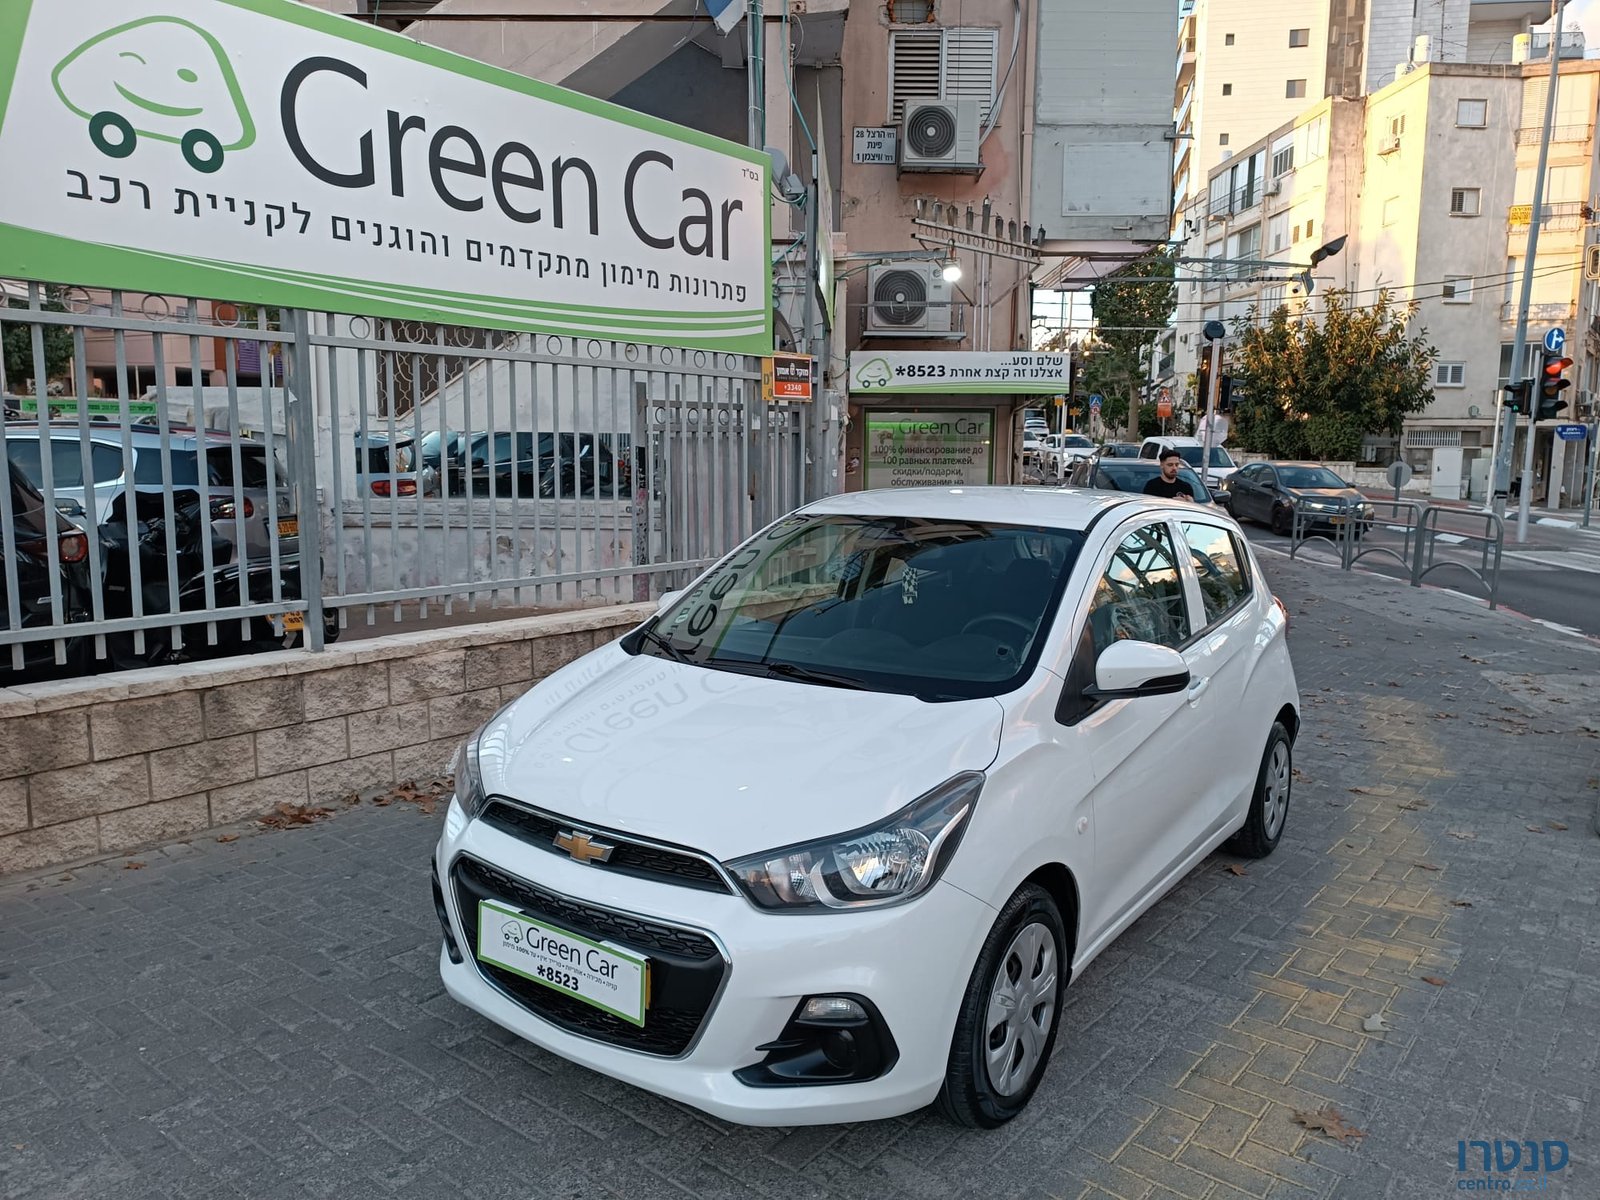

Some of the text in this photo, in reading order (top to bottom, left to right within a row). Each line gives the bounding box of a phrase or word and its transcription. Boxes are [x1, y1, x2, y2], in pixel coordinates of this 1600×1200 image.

[855, 130, 865, 138] 28
[866, 128, 886, 139] הרצל
[866, 141, 883, 149] פינת
[280, 56, 743, 262] Green Car
[855, 153, 860, 161] 1
[742, 168, 760, 182] בס"ד
[66, 168, 747, 303] פתרונות מימון מתקדמים והוגנים לקניית רכב
[1000, 355, 1063, 366] שלם וסע...
[950, 367, 1063, 380] אצלנו זה קצת אחרת
[899, 418, 985, 435] Green Car
[874, 443, 984, 456] 100% финансирование до
[883, 456, 897, 465] 100
[898, 456, 930, 467] равных
[526, 926, 619, 980] Green Car
